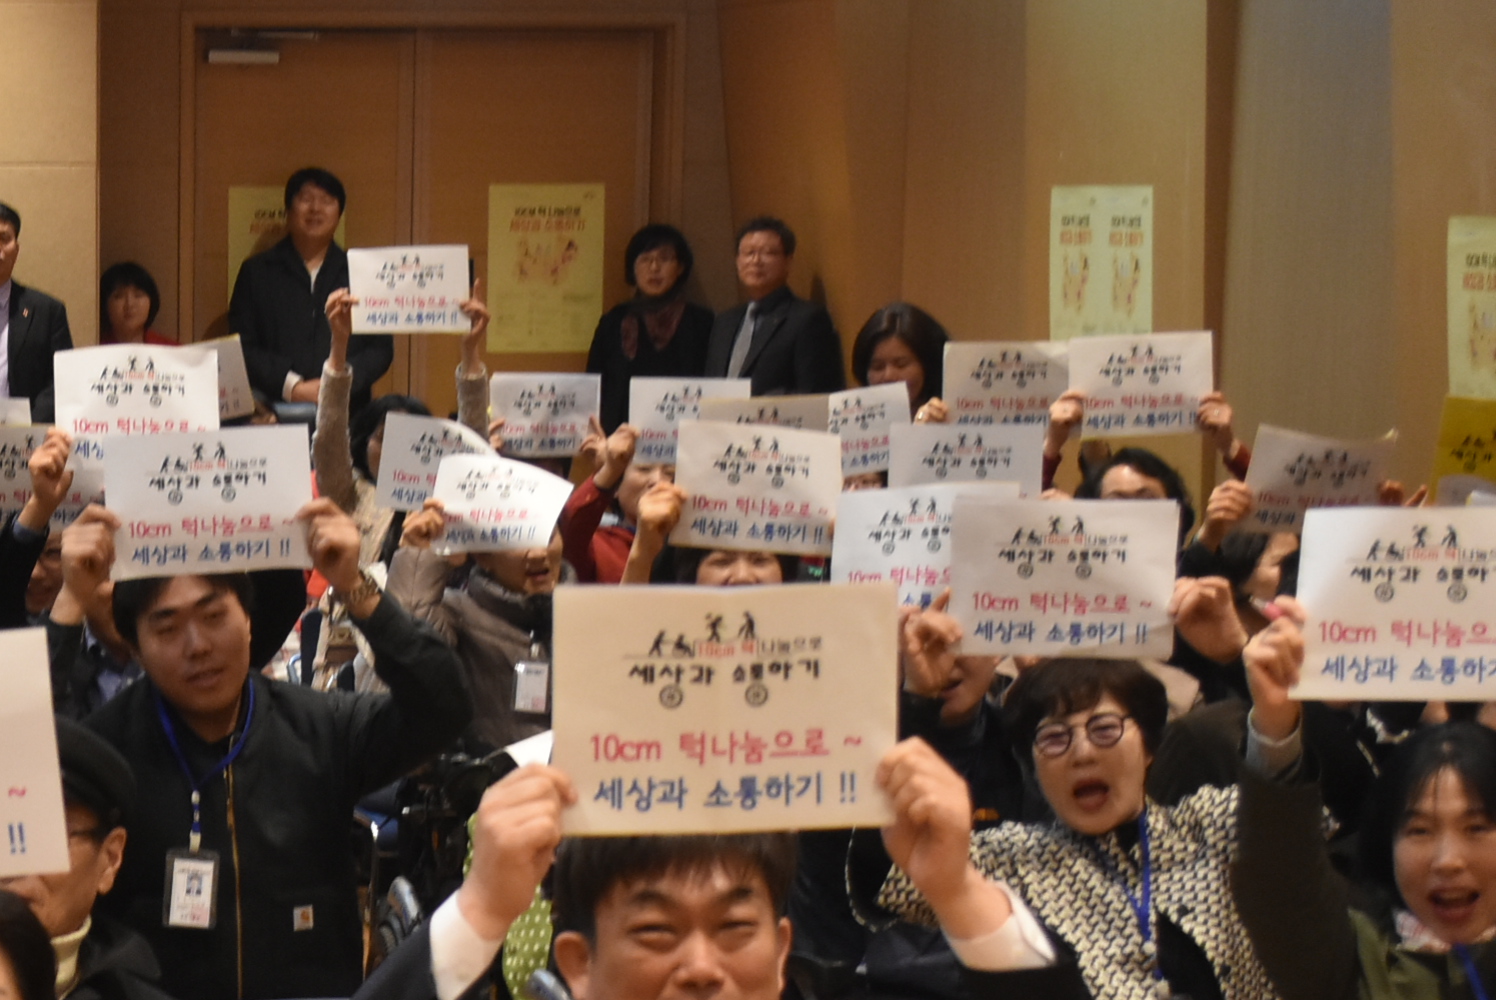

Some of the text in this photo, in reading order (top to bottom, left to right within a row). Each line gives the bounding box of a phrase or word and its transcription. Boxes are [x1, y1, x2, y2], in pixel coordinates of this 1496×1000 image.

[73, 418, 190, 436] 10cm 턱나눔으로
[74, 440, 104, 460] 세상
[691, 495, 813, 517] 10cm 턱나눔으로
[128, 515, 273, 538] 10cm 턱나눔으로
[691, 518, 740, 539] 세상과
[746, 522, 807, 541] 소통하기
[132, 544, 188, 566] 세상과
[198, 541, 269, 563] 소통하기
[972, 594, 1020, 612] 10cm
[1030, 594, 1131, 615] 턱나눔으로
[975, 621, 1037, 644] 세상과
[1047, 623, 1125, 644] 소통하기
[1319, 620, 1496, 646] 10cm 턱나눔으
[1322, 656, 1400, 683] 세상과
[590, 737, 662, 762] 10cm
[678, 729, 830, 762] 턱나눔으로
[595, 775, 689, 809] 세상과
[704, 771, 822, 807] 소통하기
